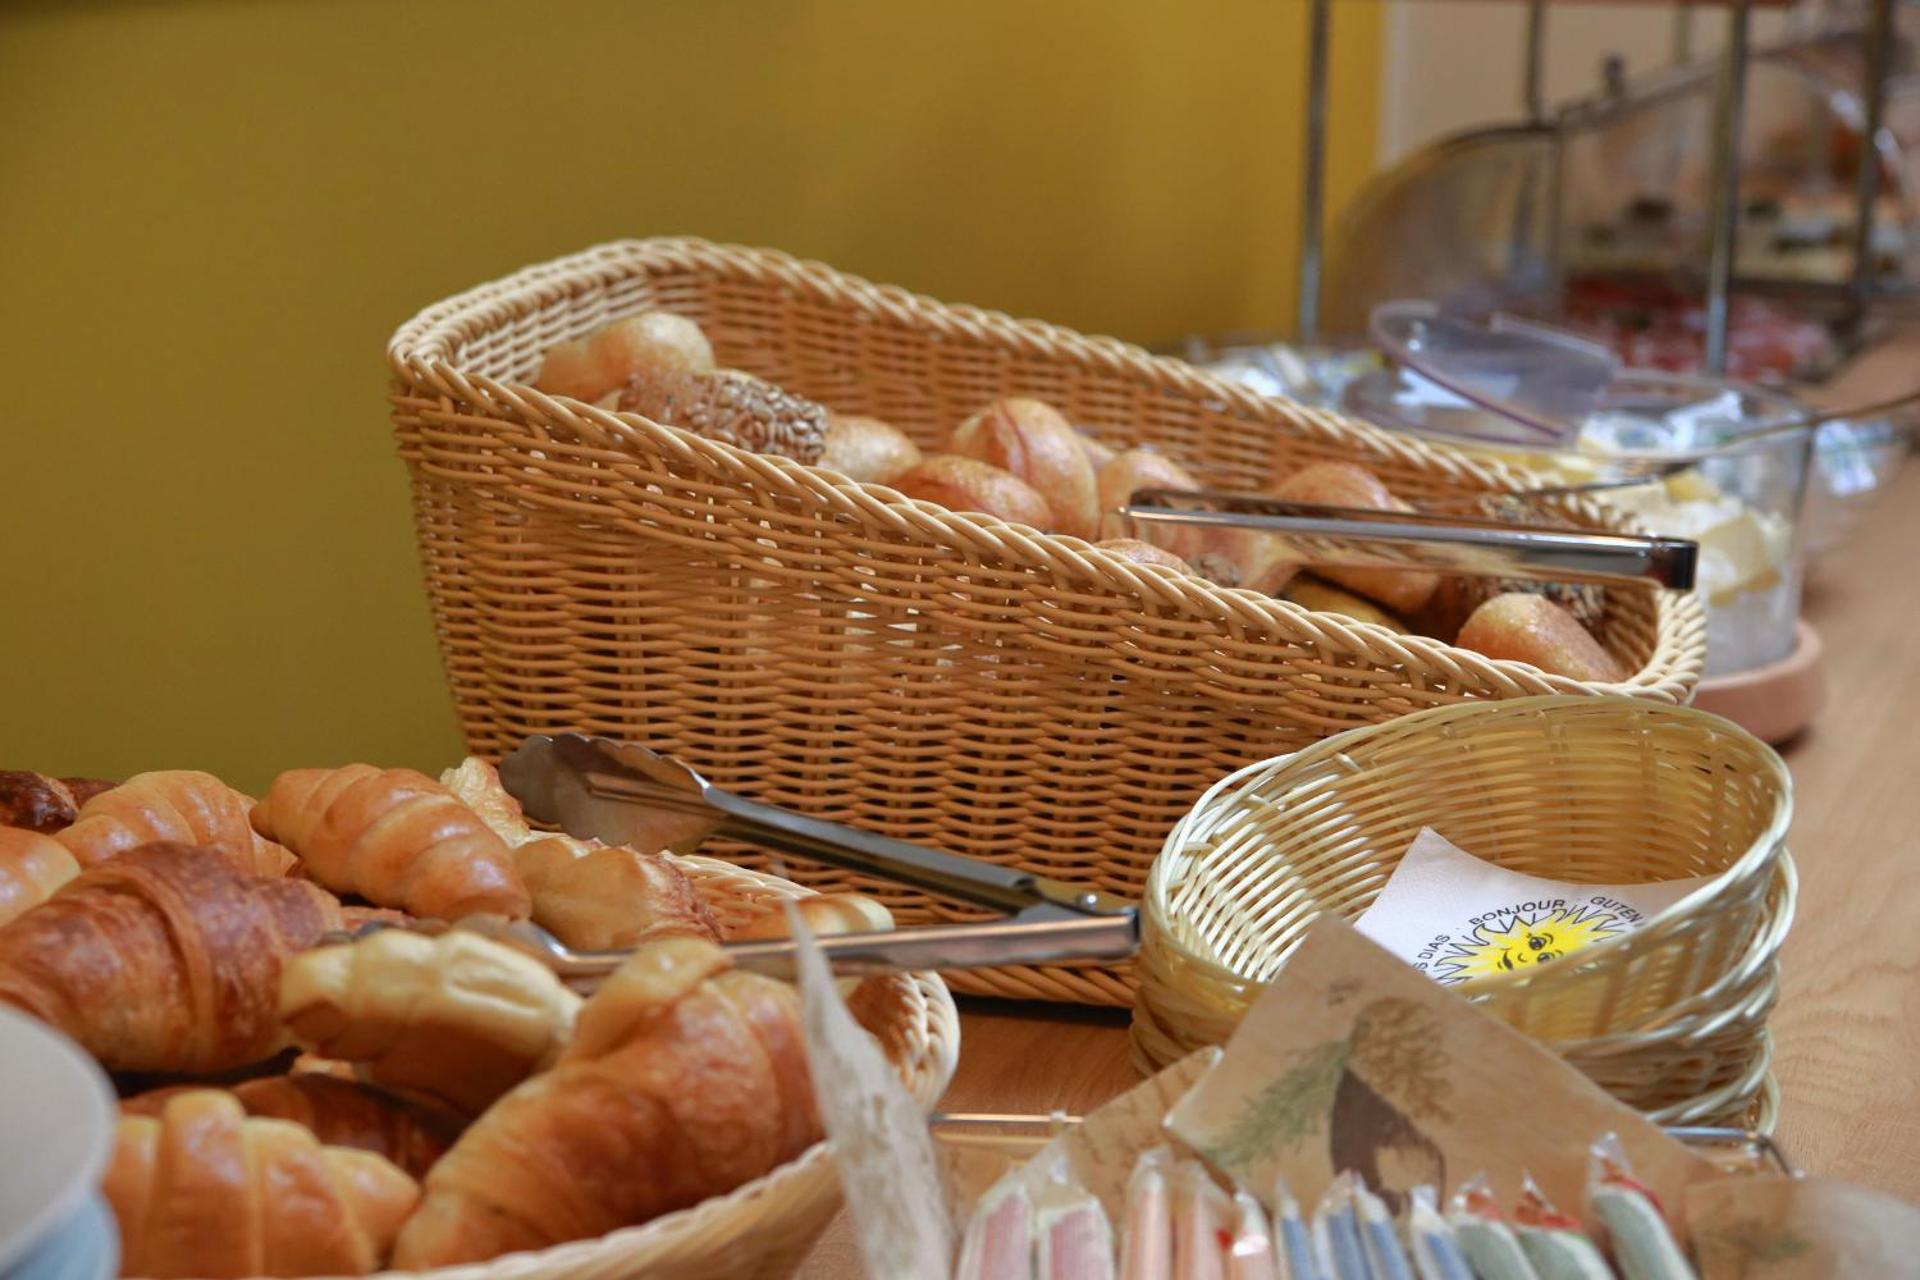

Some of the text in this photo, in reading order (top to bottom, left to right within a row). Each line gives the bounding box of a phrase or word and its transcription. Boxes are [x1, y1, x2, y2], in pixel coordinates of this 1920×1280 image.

[1417, 896, 1645, 960] DIAS BONJOUR GUTEN
